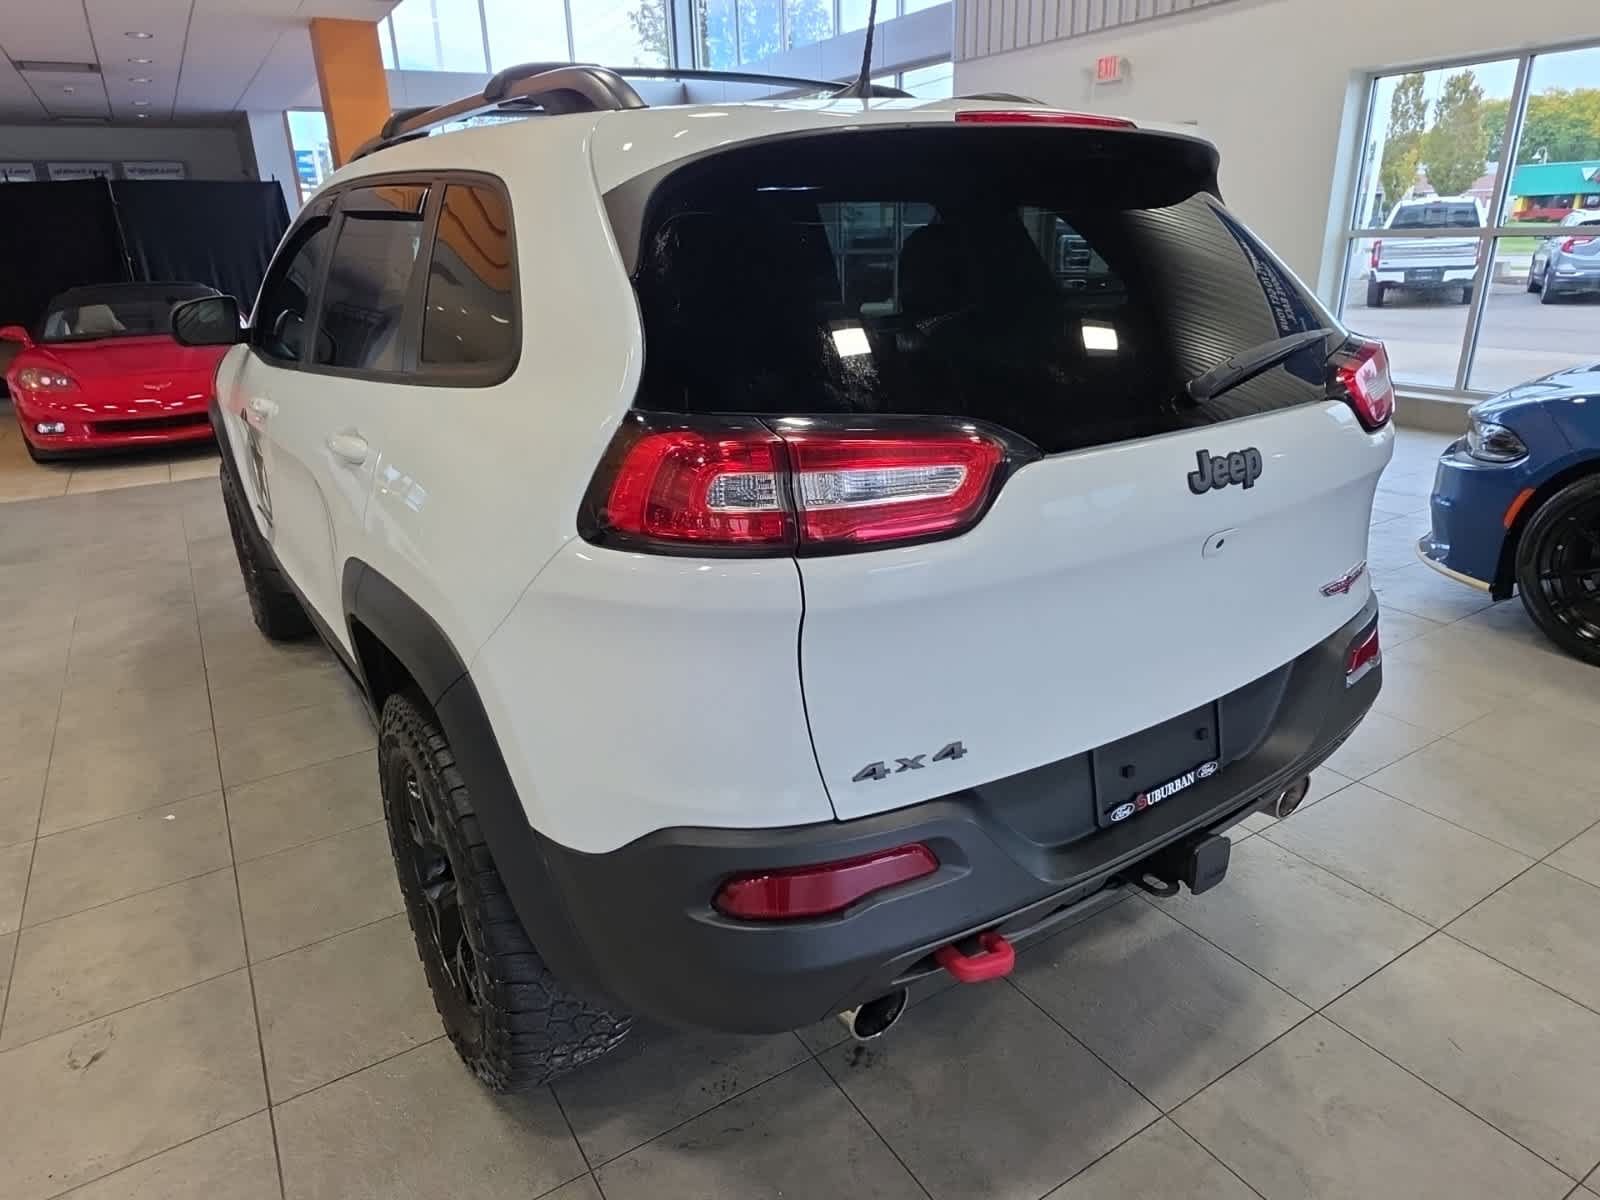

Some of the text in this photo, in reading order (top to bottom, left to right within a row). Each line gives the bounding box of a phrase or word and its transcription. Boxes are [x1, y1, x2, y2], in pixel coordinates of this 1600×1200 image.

[1187, 447, 1262, 495] Jeep
[852, 741, 967, 782] 4x4
[1135, 771, 1195, 811] SUBURBAN
